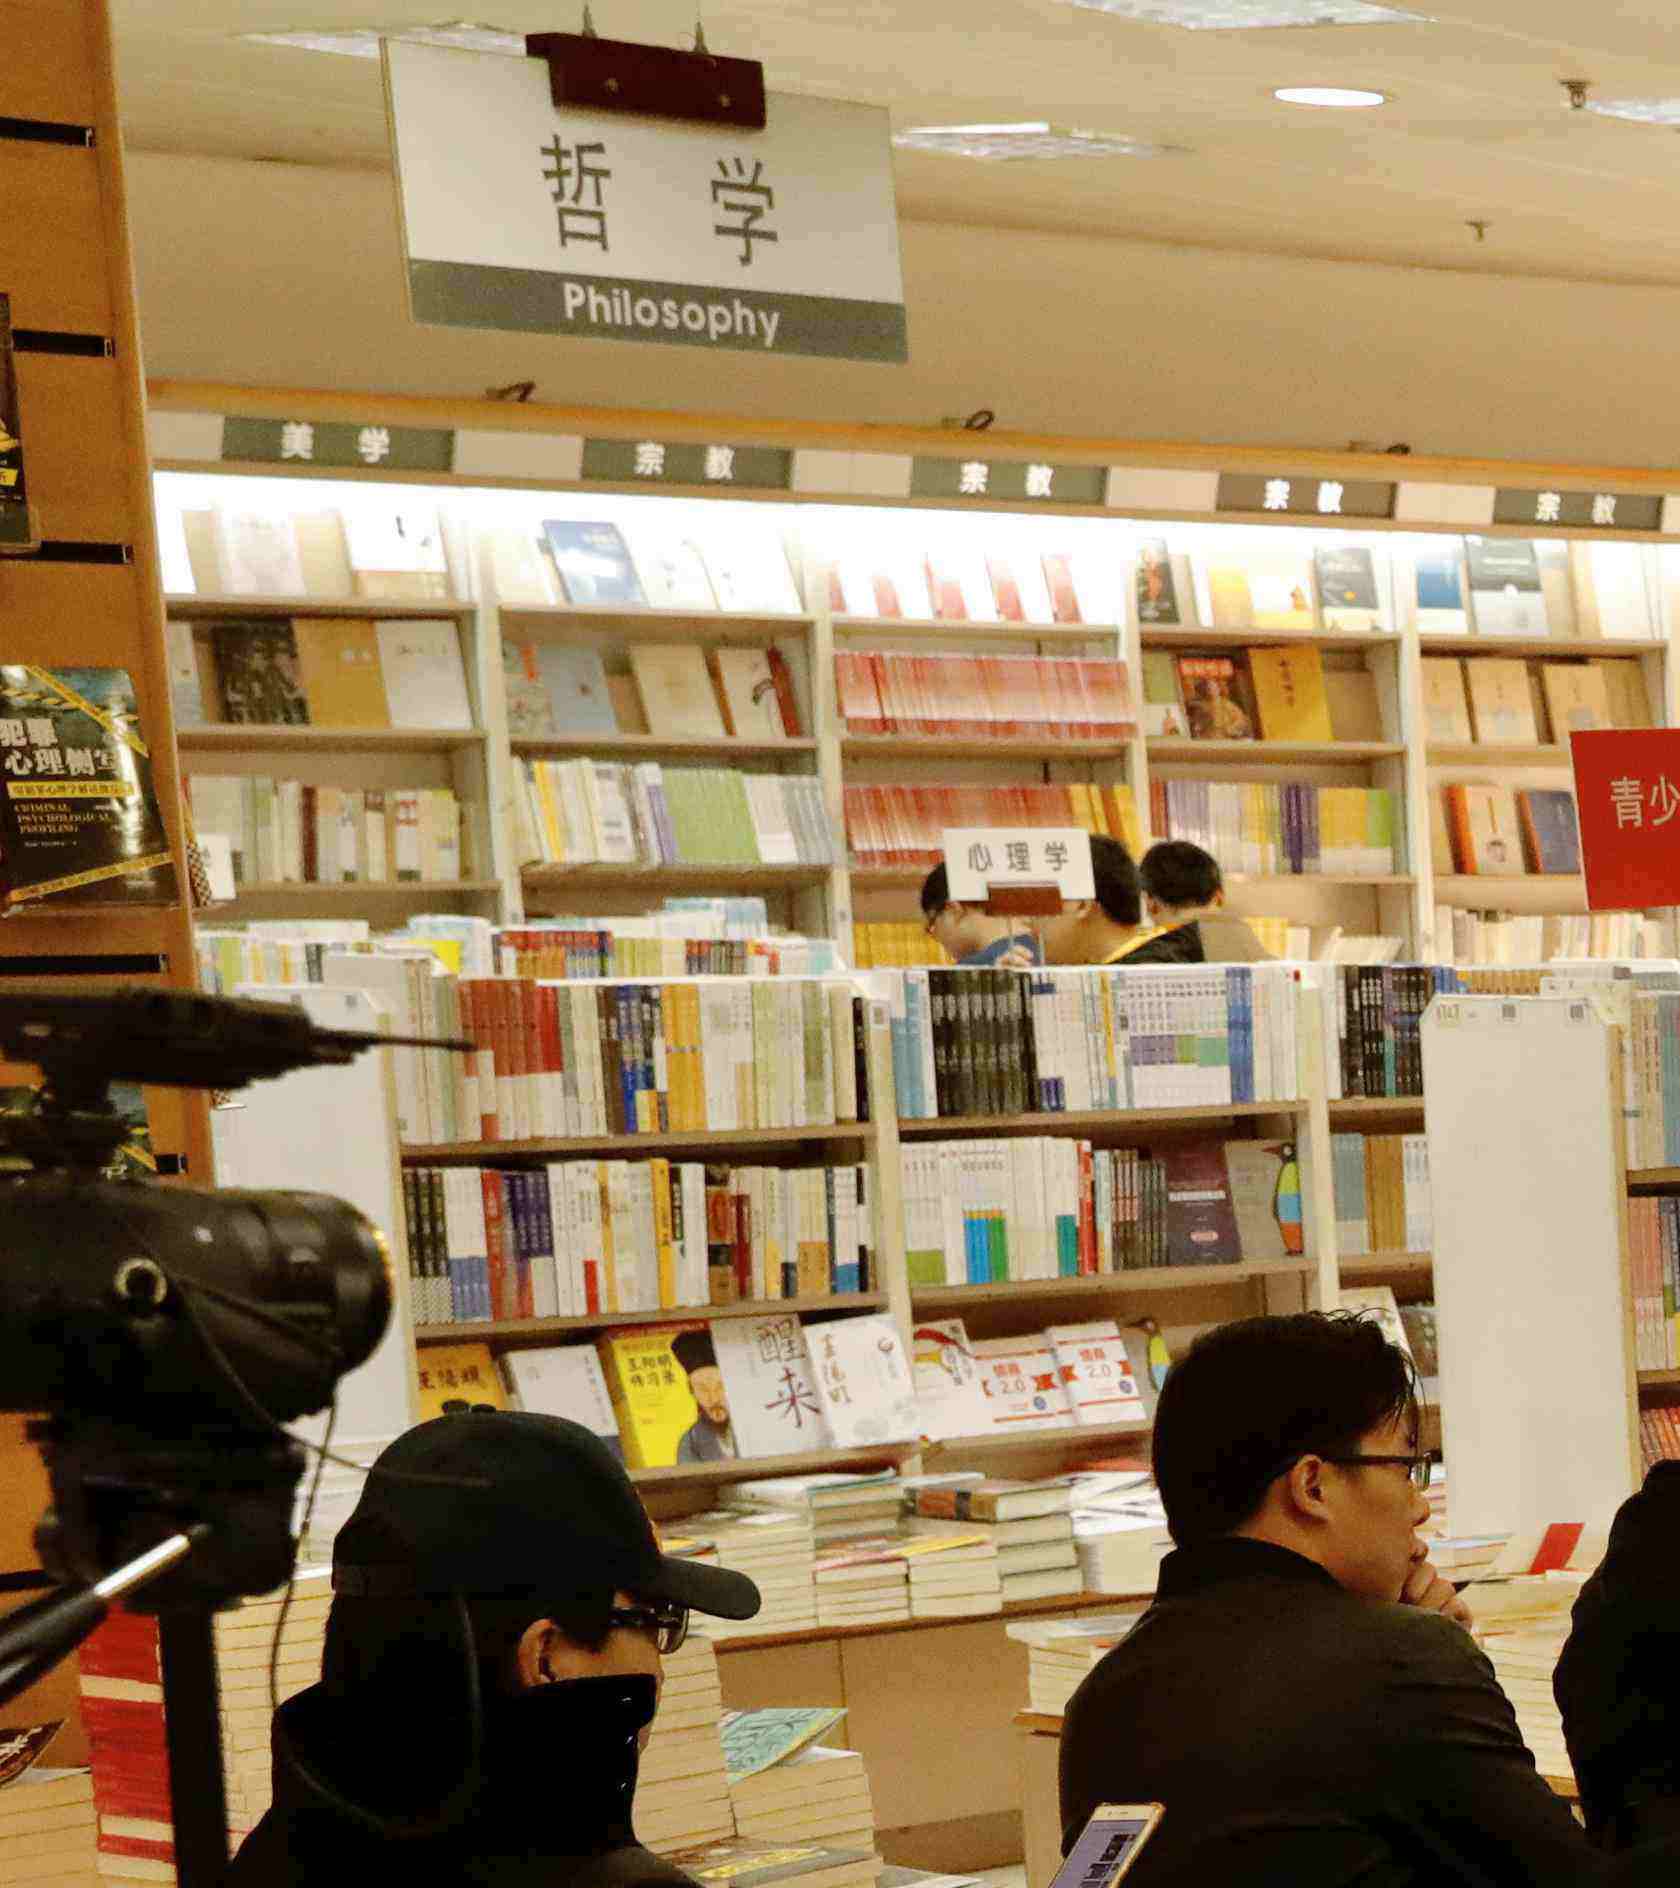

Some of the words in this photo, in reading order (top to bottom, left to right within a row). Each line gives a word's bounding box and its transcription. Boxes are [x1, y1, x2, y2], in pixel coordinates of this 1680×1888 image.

[541, 134, 778, 266] 哲学
[562, 281, 781, 346] Philosophy
[281, 424, 391, 463] 美学
[634, 443, 736, 482] 宗教
[968, 841, 1068, 871] 心理学
